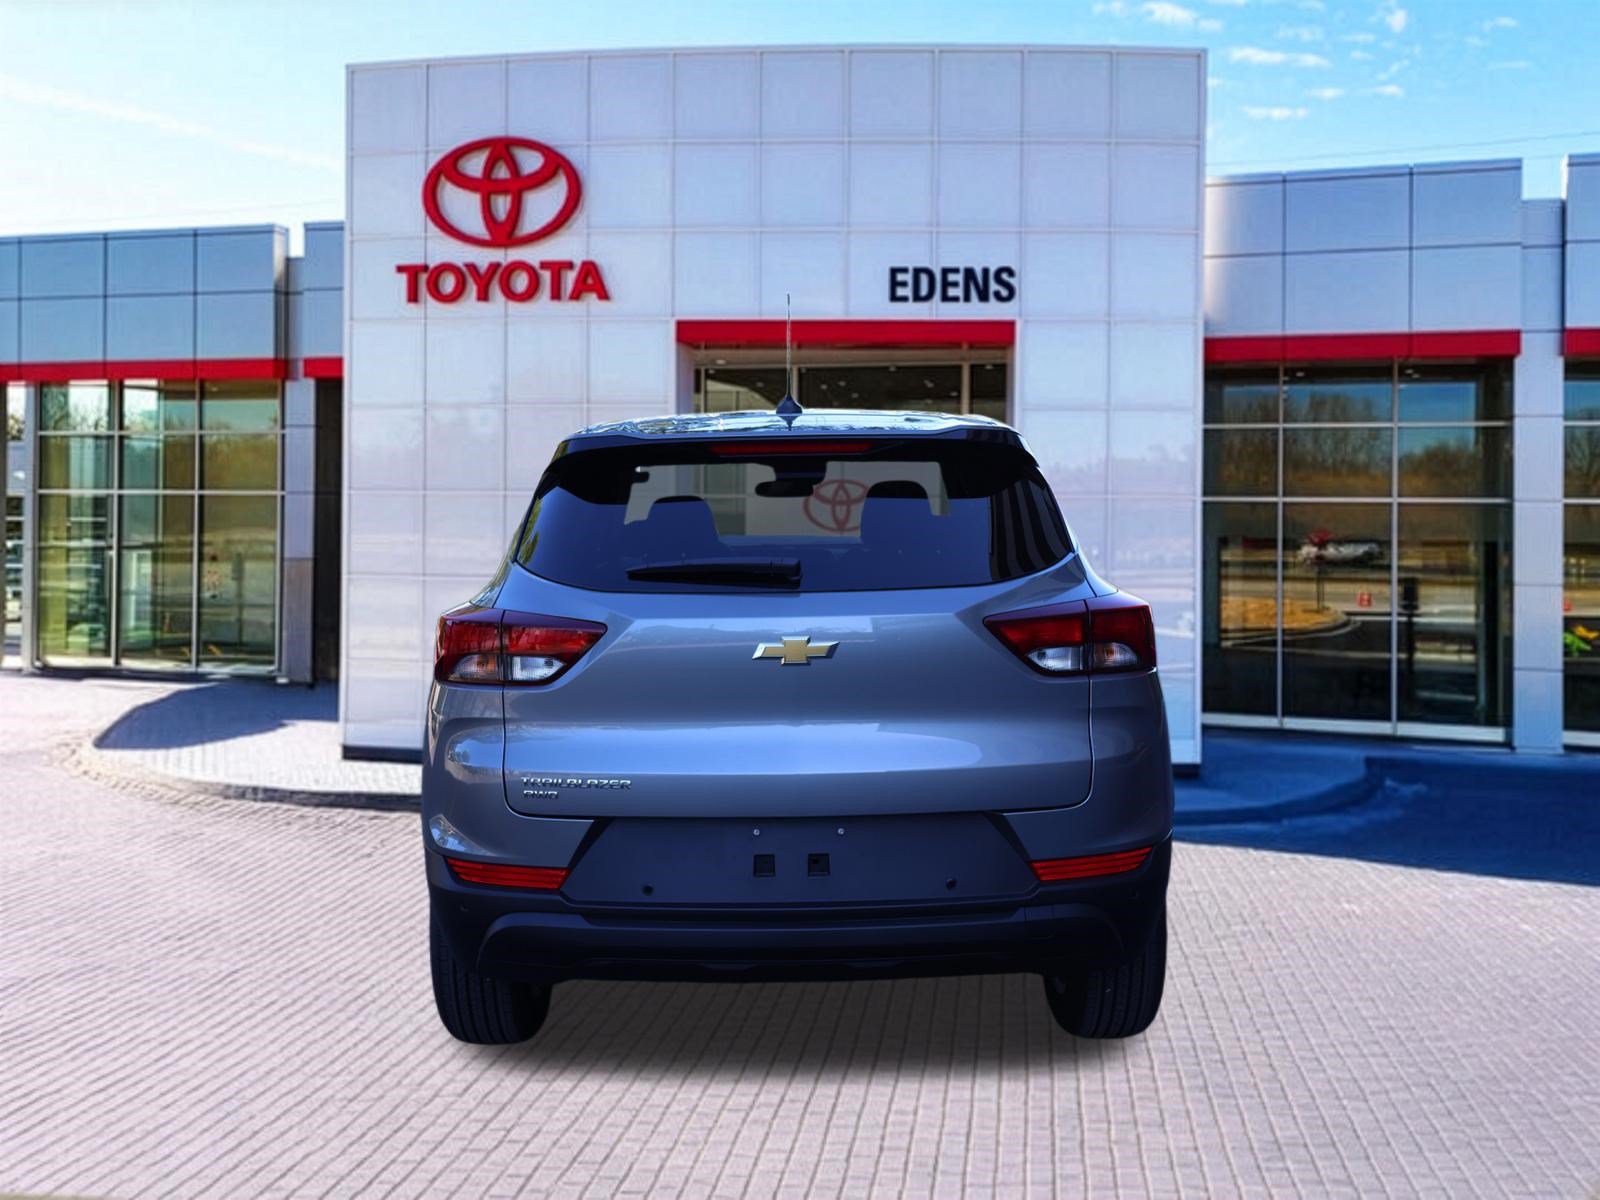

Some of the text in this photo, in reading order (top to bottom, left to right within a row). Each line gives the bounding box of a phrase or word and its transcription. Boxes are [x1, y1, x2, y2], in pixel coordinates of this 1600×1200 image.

[396, 260, 611, 304] TOYOTA
[889, 266, 1016, 303] EDENS
[521, 777, 632, 790] TRAILBLAZER
[523, 790, 559, 800] AWD
